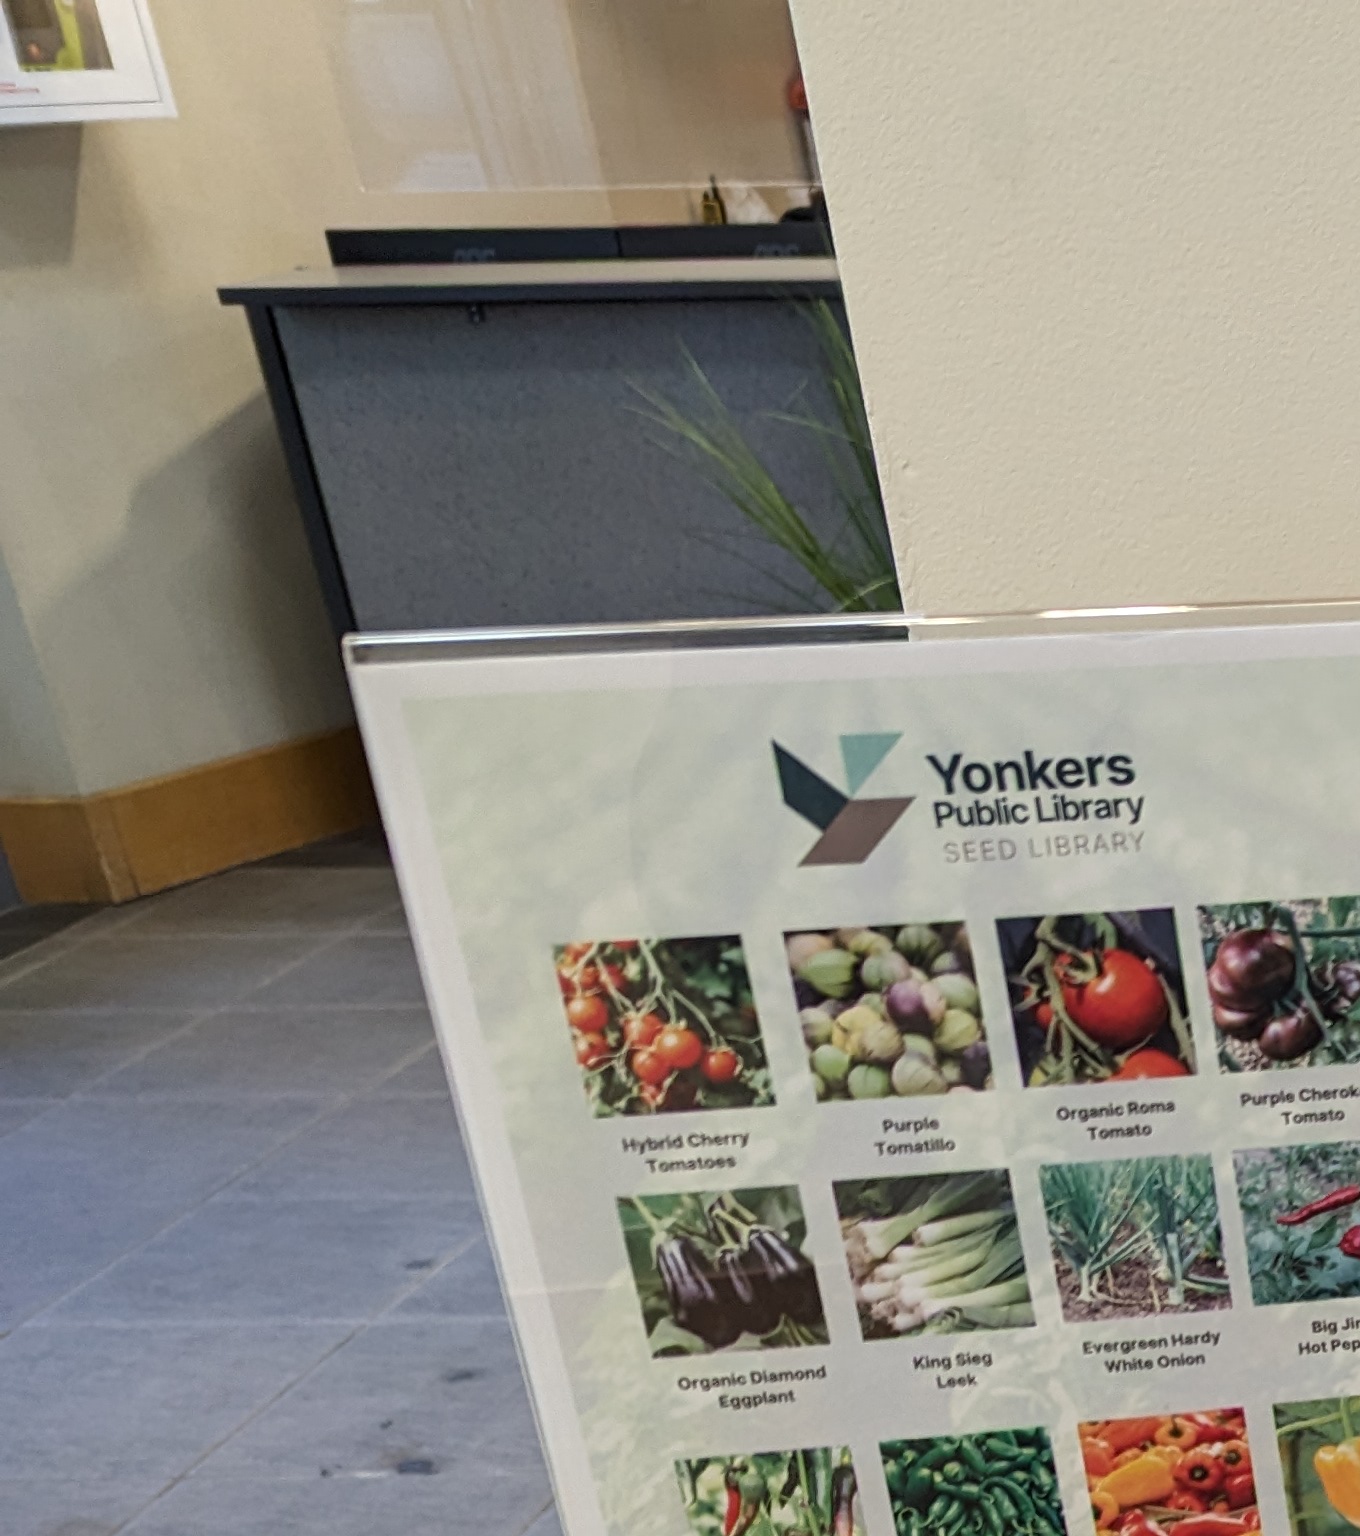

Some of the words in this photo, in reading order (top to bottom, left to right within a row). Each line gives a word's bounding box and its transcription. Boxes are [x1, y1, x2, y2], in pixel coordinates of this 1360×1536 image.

[925, 750, 1136, 795] Yonkers
[933, 796, 1031, 829] Public
[1034, 793, 1144, 825] Library
[943, 838, 1017, 864] SEED
[1027, 830, 1145, 859] LIBRARY
[1239, 1090, 1296, 1109] Purple
[1055, 1103, 1125, 1123] Organic
[1126, 1101, 1176, 1116] Roma
[1280, 1109, 1346, 1126] Tomato
[881, 1117, 940, 1135] Purple
[1086, 1123, 1153, 1141] Tomato
[621, 1134, 685, 1155] Hybrid
[686, 1132, 750, 1149] Cherry
[873, 1138, 956, 1156] Tomatillo
[645, 1156, 737, 1173] Tomatoes
[1311, 1320, 1338, 1336] Big
[1082, 1337, 1169, 1355] Evergreen
[1170, 1330, 1221, 1347] Hardy
[1298, 1341, 1328, 1356] Hot
[912, 1355, 953, 1371] King
[1103, 1358, 1154, 1374] White
[1156, 1353, 1206, 1369] Onion
[677, 1373, 747, 1393] Organic
[749, 1365, 827, 1385] Diamond
[936, 1372, 978, 1389] Leek
[718, 1389, 796, 1410] Eggplant
